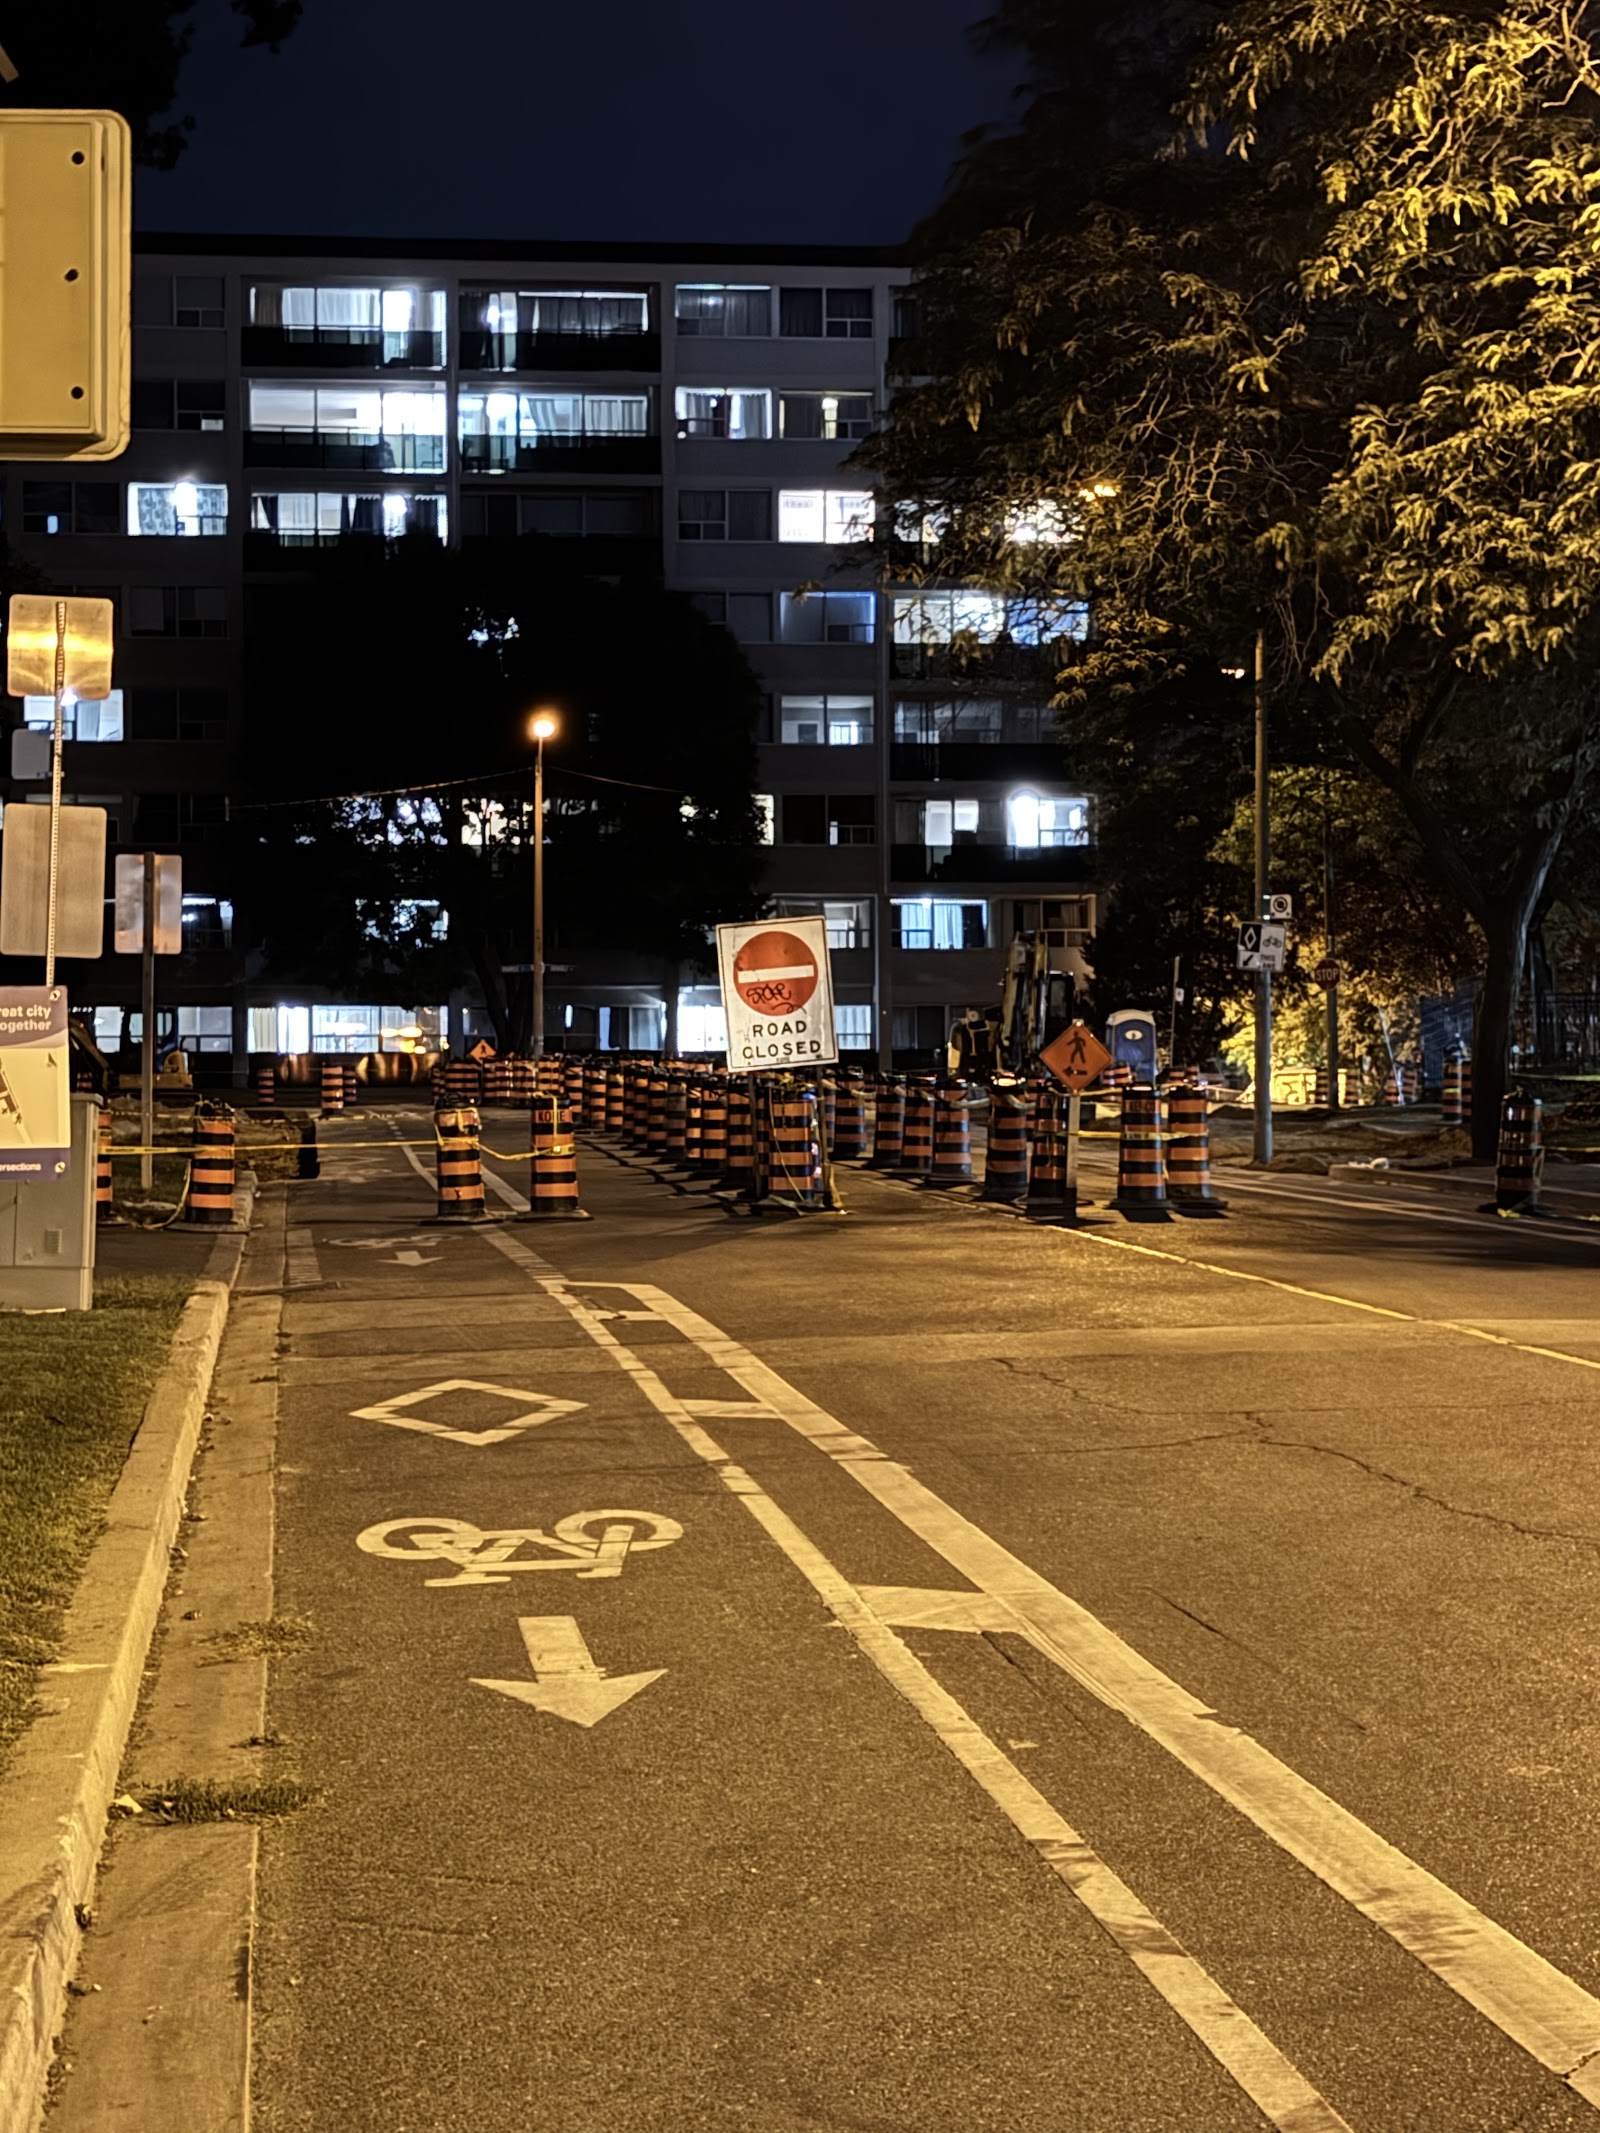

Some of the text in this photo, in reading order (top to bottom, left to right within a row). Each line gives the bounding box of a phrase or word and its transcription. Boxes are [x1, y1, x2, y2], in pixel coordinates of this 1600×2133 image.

[1316, 968, 1339, 982] STOP
[26, 1004, 51, 1019] city
[0, 1019, 51, 1034] ogether
[753, 1020, 807, 1037] ROAD
[742, 1040, 821, 1059] CLOSED
